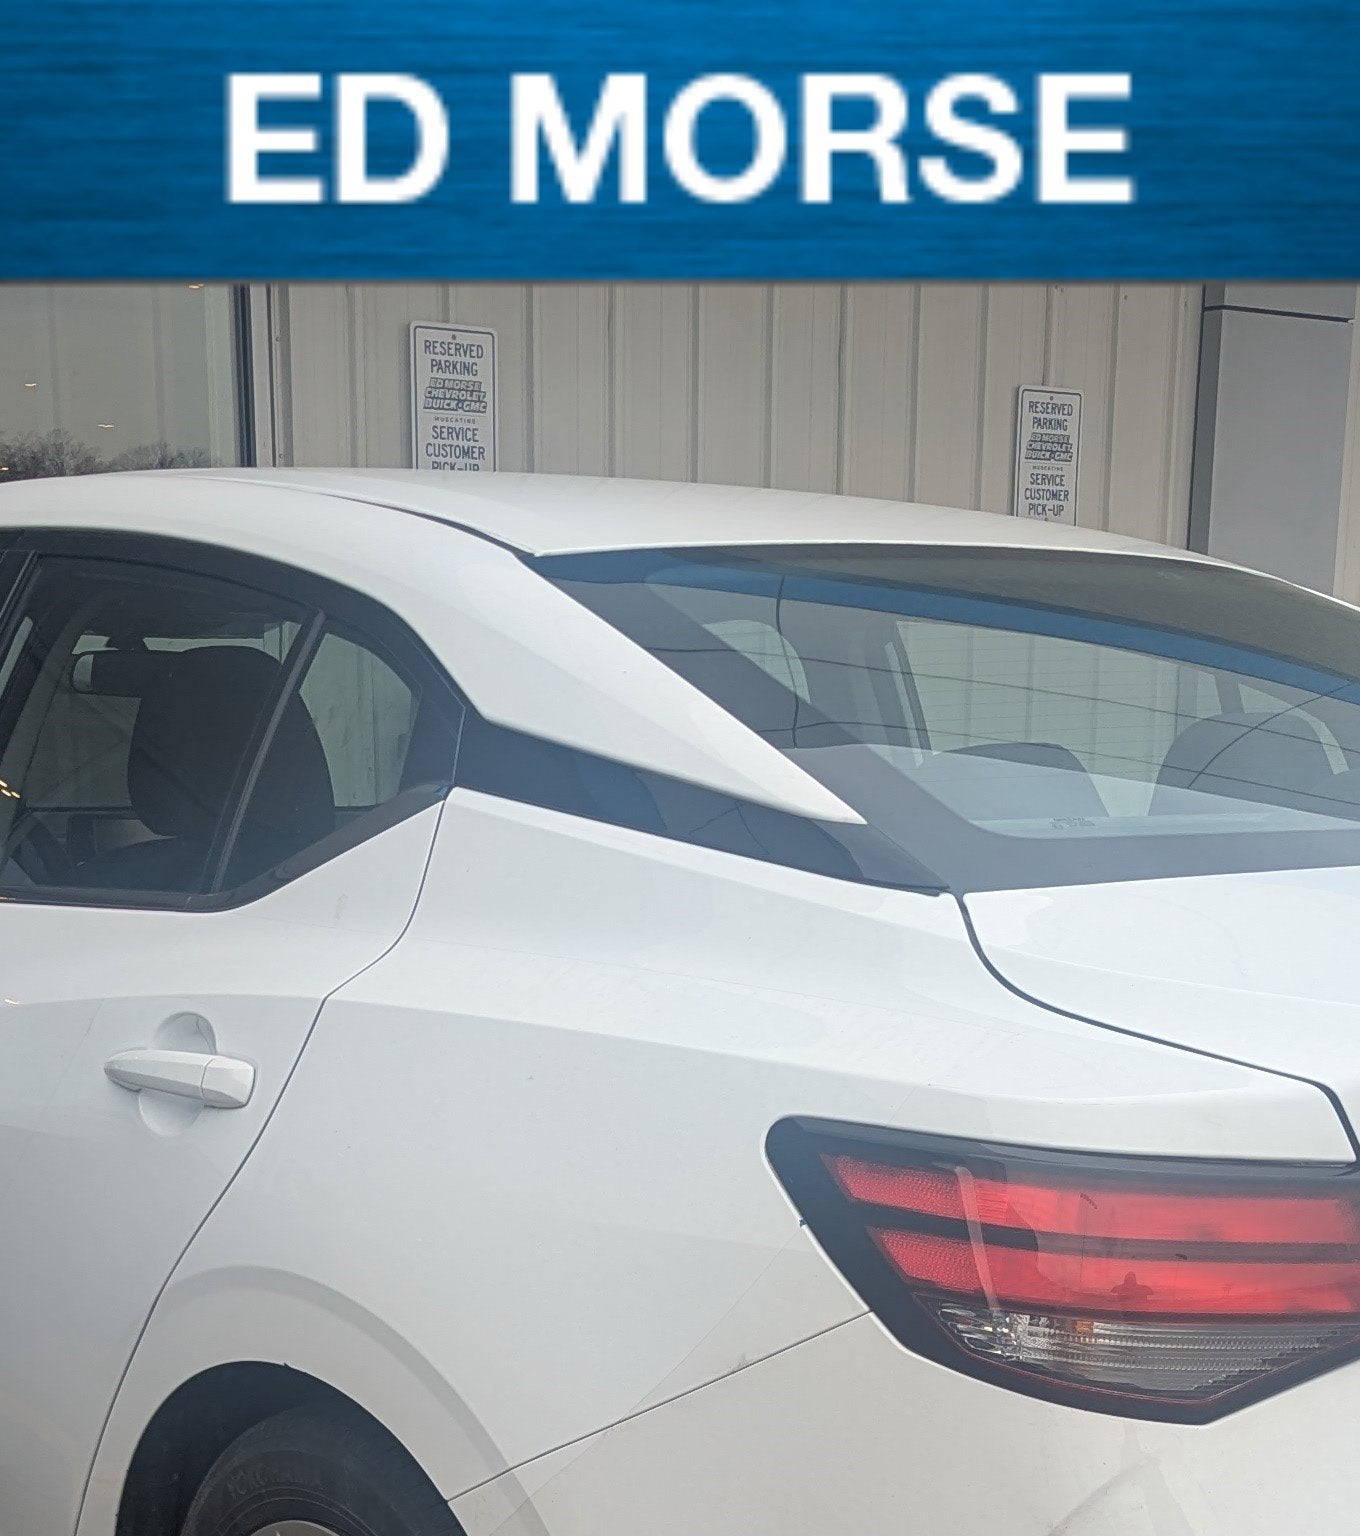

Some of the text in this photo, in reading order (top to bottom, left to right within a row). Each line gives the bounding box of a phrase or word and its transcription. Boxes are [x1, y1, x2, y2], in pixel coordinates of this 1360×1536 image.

[424, 339, 484, 359] RESERVED
[430, 359, 478, 377] PARKING
[424, 388, 487, 402] CHEVROLET
[1028, 400, 1073, 417] RESERVED
[1032, 417, 1068, 431] PARKING
[432, 425, 479, 443] SERVICE
[425, 443, 486, 461] CUSTOMER
[1029, 472, 1065, 487] SERVICE
[1024, 487, 1070, 502] CUSTOMER
[1028, 503, 1065, 517] PICK-UP
